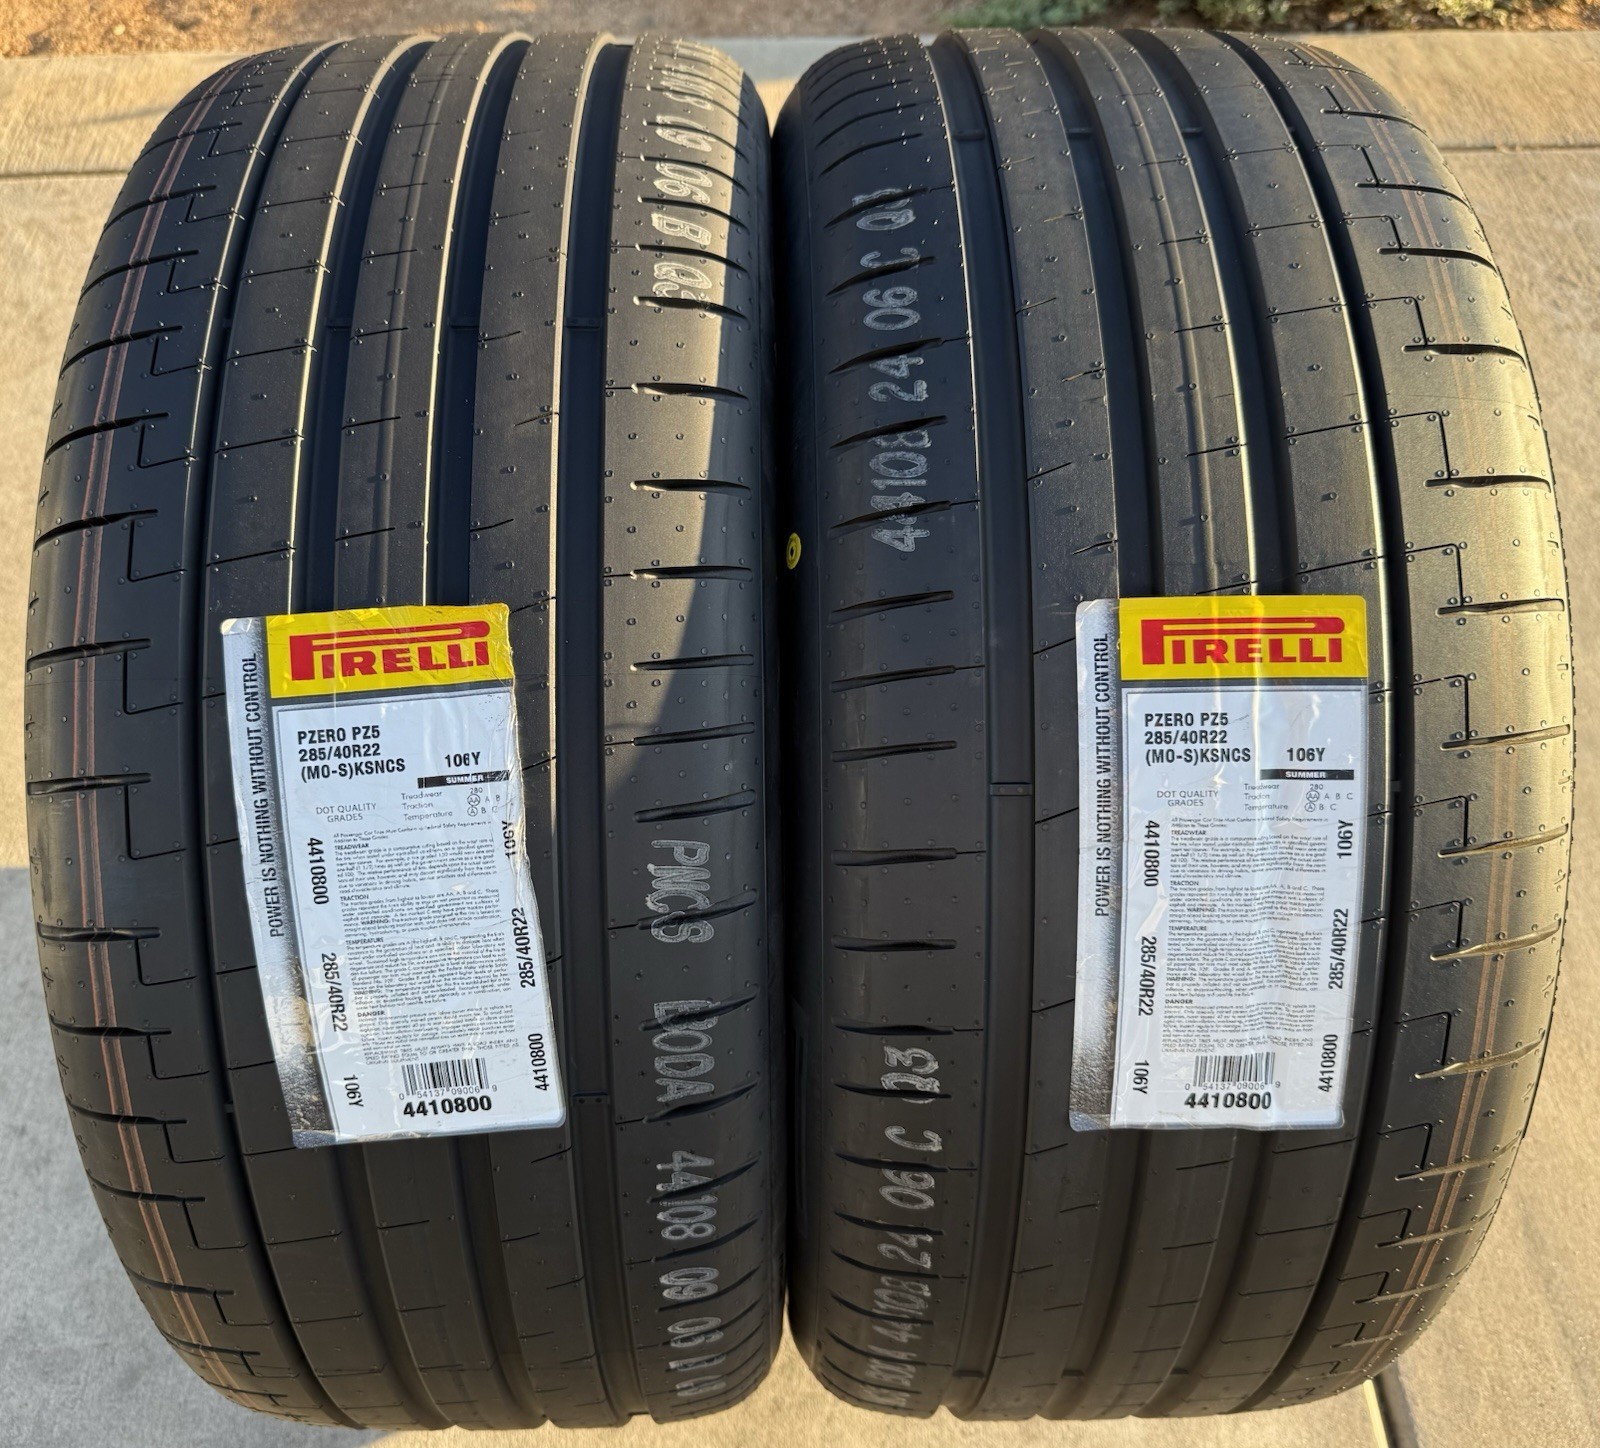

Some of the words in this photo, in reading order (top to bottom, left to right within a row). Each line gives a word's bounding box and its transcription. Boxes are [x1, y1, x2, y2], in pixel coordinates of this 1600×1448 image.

[653, 160, 713, 205] 06
[651, 212, 712, 246] B
[862, 285, 921, 331] 06
[289, 620, 491, 681] PIRELLI
[1140, 616, 1345, 665] PIRELLI
[1093, 633, 1110, 702] CONTROL
[242, 653, 262, 722] CONTROL
[297, 728, 346, 745] PZERO
[352, 725, 381, 740] PZ5
[1144, 712, 1194, 727] PZERO
[1200, 712, 1229, 727] PZ5
[298, 743, 381, 763] 285/40R22
[1095, 706, 1112, 778] WITHOUT
[1144, 730, 1228, 745] 285/40R22
[247, 727, 270, 797] WITHOUT
[445, 751, 482, 769] 106Y
[1286, 748, 1326, 762] 106Y
[445, 774, 485, 784] SUMMER
[1285, 770, 1327, 779] SUMMER
[316, 805, 335, 815] DOT
[337, 803, 377, 814] QUALITY
[402, 801, 434, 810] Traction
[1157, 790, 1176, 798] DOT
[1179, 790, 1218, 799] QUALITY
[1167, 799, 1204, 807] GRADES
[327, 813, 363, 823] GRADES
[404, 810, 454, 821] Temperature
[1095, 779, 1111, 845] NOTHING
[255, 798, 273, 865] NOTHING
[334, 842, 370, 851] TREADWEAR
[1337, 819, 1354, 859] 106Y
[1096, 847, 1110, 859] IS
[1143, 819, 1160, 887] 4410800
[261, 866, 277, 882] IS
[307, 837, 330, 905] 4410800
[340, 894, 370, 902] TRACTION
[1095, 861, 1111, 917] POWER
[262, 884, 285, 938] POWER
[345, 937, 384, 946] TEMPERATURE
[511, 907, 536, 989] 285/40R22
[1328, 908, 1349, 990] 285/40R22
[322, 952, 349, 1032] 285/40R22
[1138, 936, 1157, 1017] 285/40R22
[528, 1033, 550, 1092] 4410800
[1133, 1059, 1150, 1094] 106Y
[1317, 1034, 1339, 1093] 4410800
[343, 1074, 364, 1108] 106Y
[416, 1089, 446, 1099] 54137
[451, 1086, 480, 1096] 09006
[1184, 1091, 1272, 1110] 4410800
[1203, 1082, 1231, 1091] 54137
[1236, 1081, 1265, 1091] 09006
[1275, 1081, 1281, 1089] 9
[403, 1095, 492, 1118] 4410800
[884, 1125, 943, 1151] C
[879, 1160, 935, 1210] 06
[659, 1266, 720, 1301] 09
